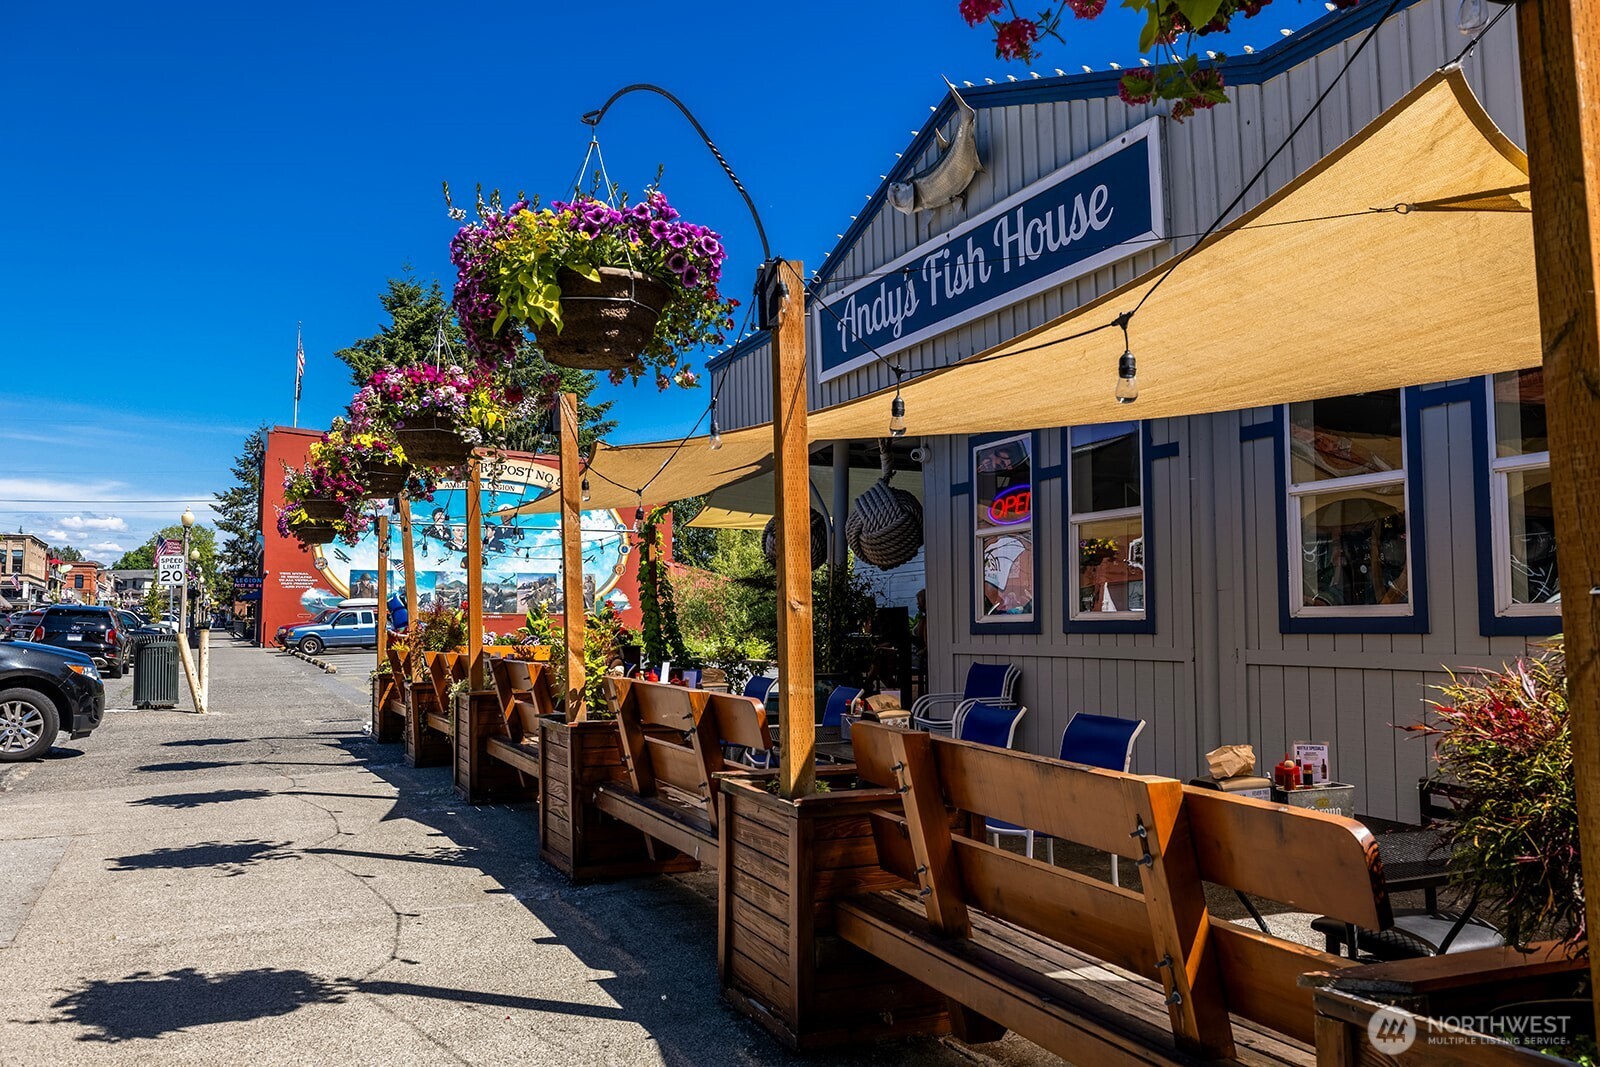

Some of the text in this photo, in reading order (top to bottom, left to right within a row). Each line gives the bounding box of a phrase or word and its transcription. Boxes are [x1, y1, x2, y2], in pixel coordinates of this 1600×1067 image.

[837, 184, 1114, 352] Andy's Fish House
[500, 464, 534, 478] POST
[487, 481, 515, 492] LGION
[160, 570, 183, 582] 20
[1305, 805, 1342, 816] rona
